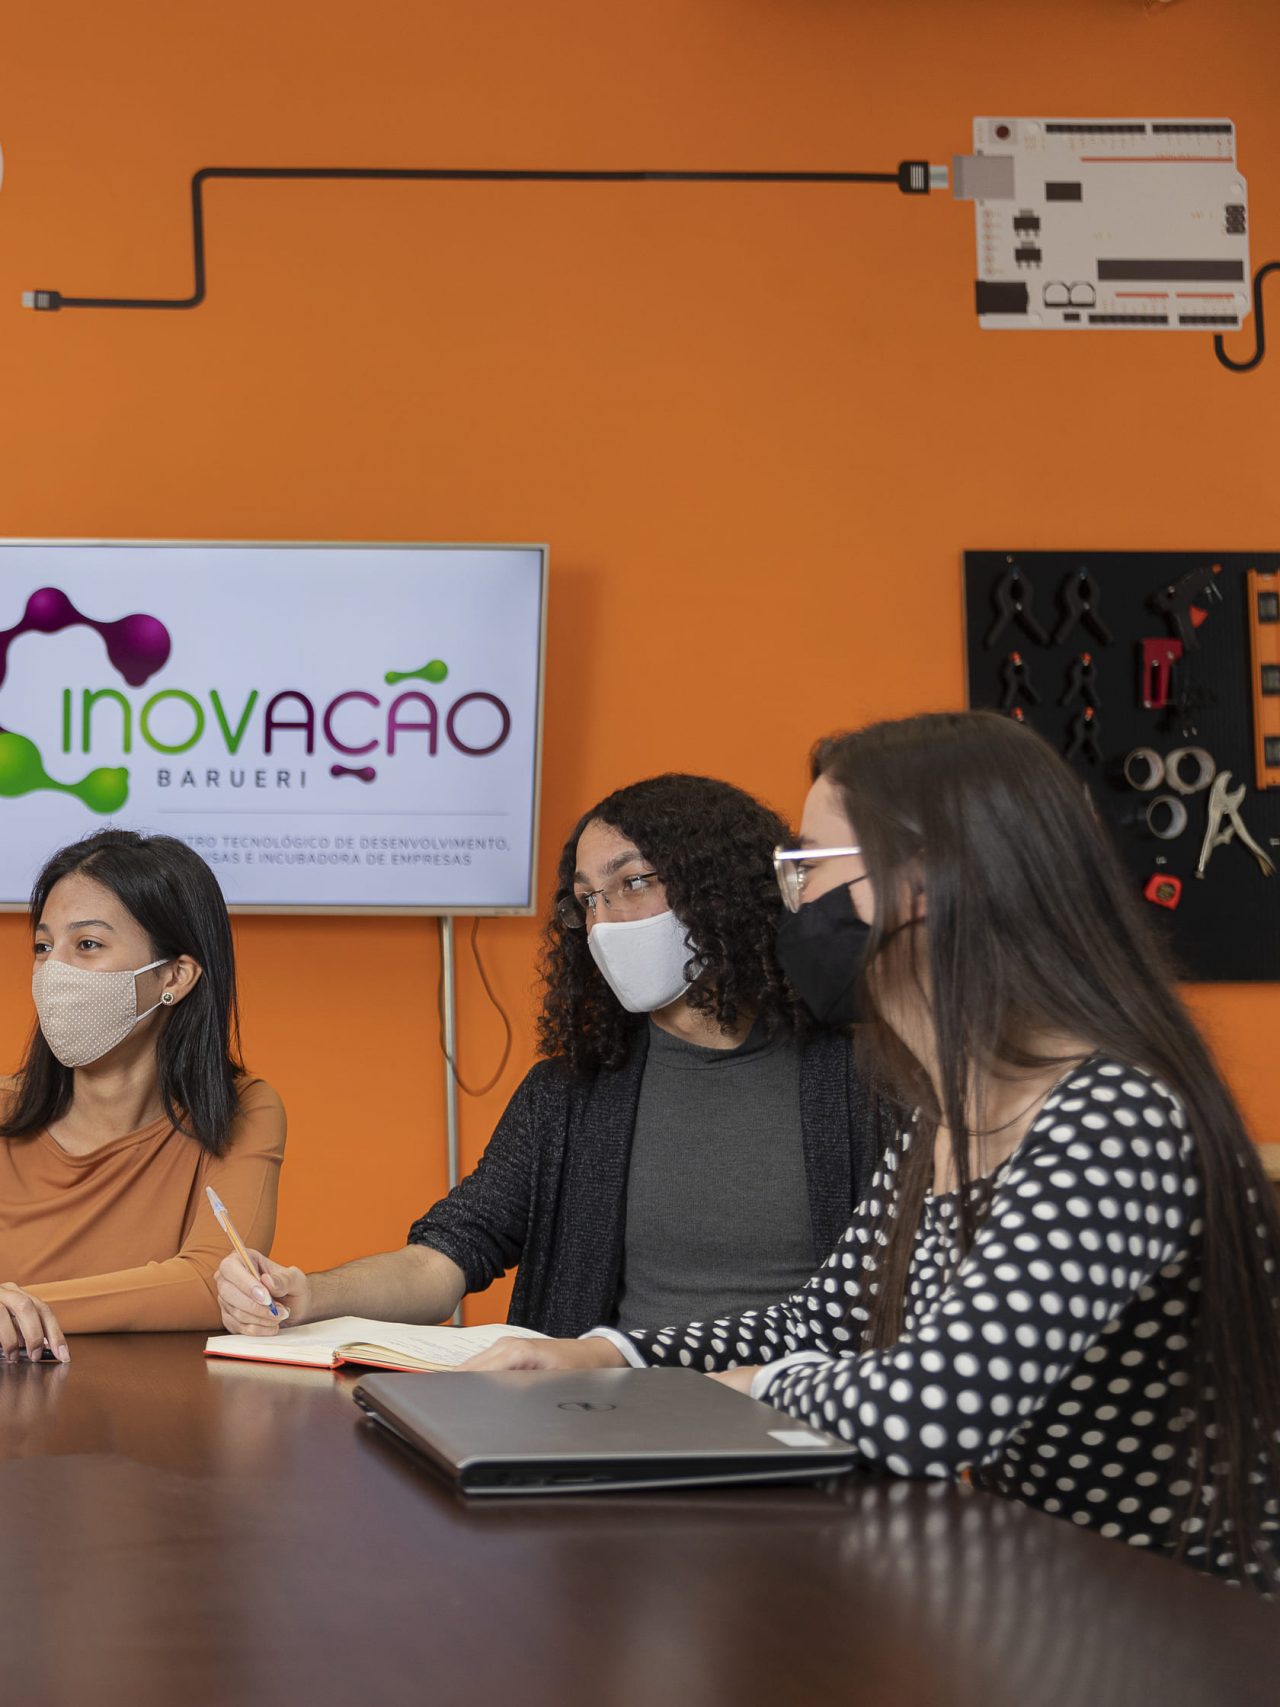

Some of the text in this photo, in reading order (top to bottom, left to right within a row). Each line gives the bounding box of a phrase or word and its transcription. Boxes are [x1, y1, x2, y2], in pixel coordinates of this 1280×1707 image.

[157, 769, 307, 788] BARUERI
[186, 835, 510, 851] TRO TECNOLÓGICO DE DESENVOLVIMENTO,
[245, 853, 254, 864] E
[259, 853, 360, 865] INCUBADORA
[366, 854, 386, 866] DE
[391, 854, 472, 866] EMPRESAS
